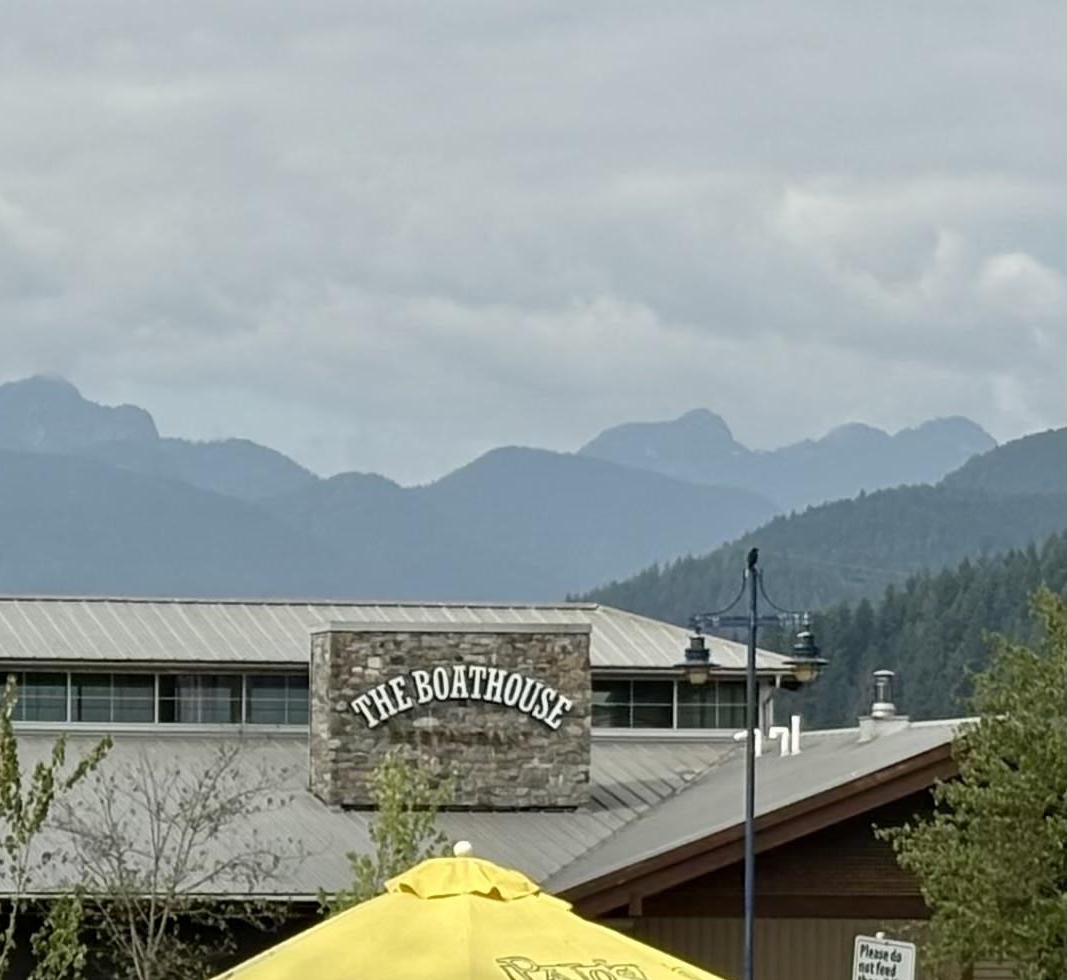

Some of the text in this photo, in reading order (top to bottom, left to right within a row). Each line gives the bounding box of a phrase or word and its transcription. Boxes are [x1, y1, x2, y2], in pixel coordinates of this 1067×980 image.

[351, 665, 573, 731] THE BOATHOUSE
[859, 943, 902, 964] Please do
[858, 961, 897, 978] not feed
